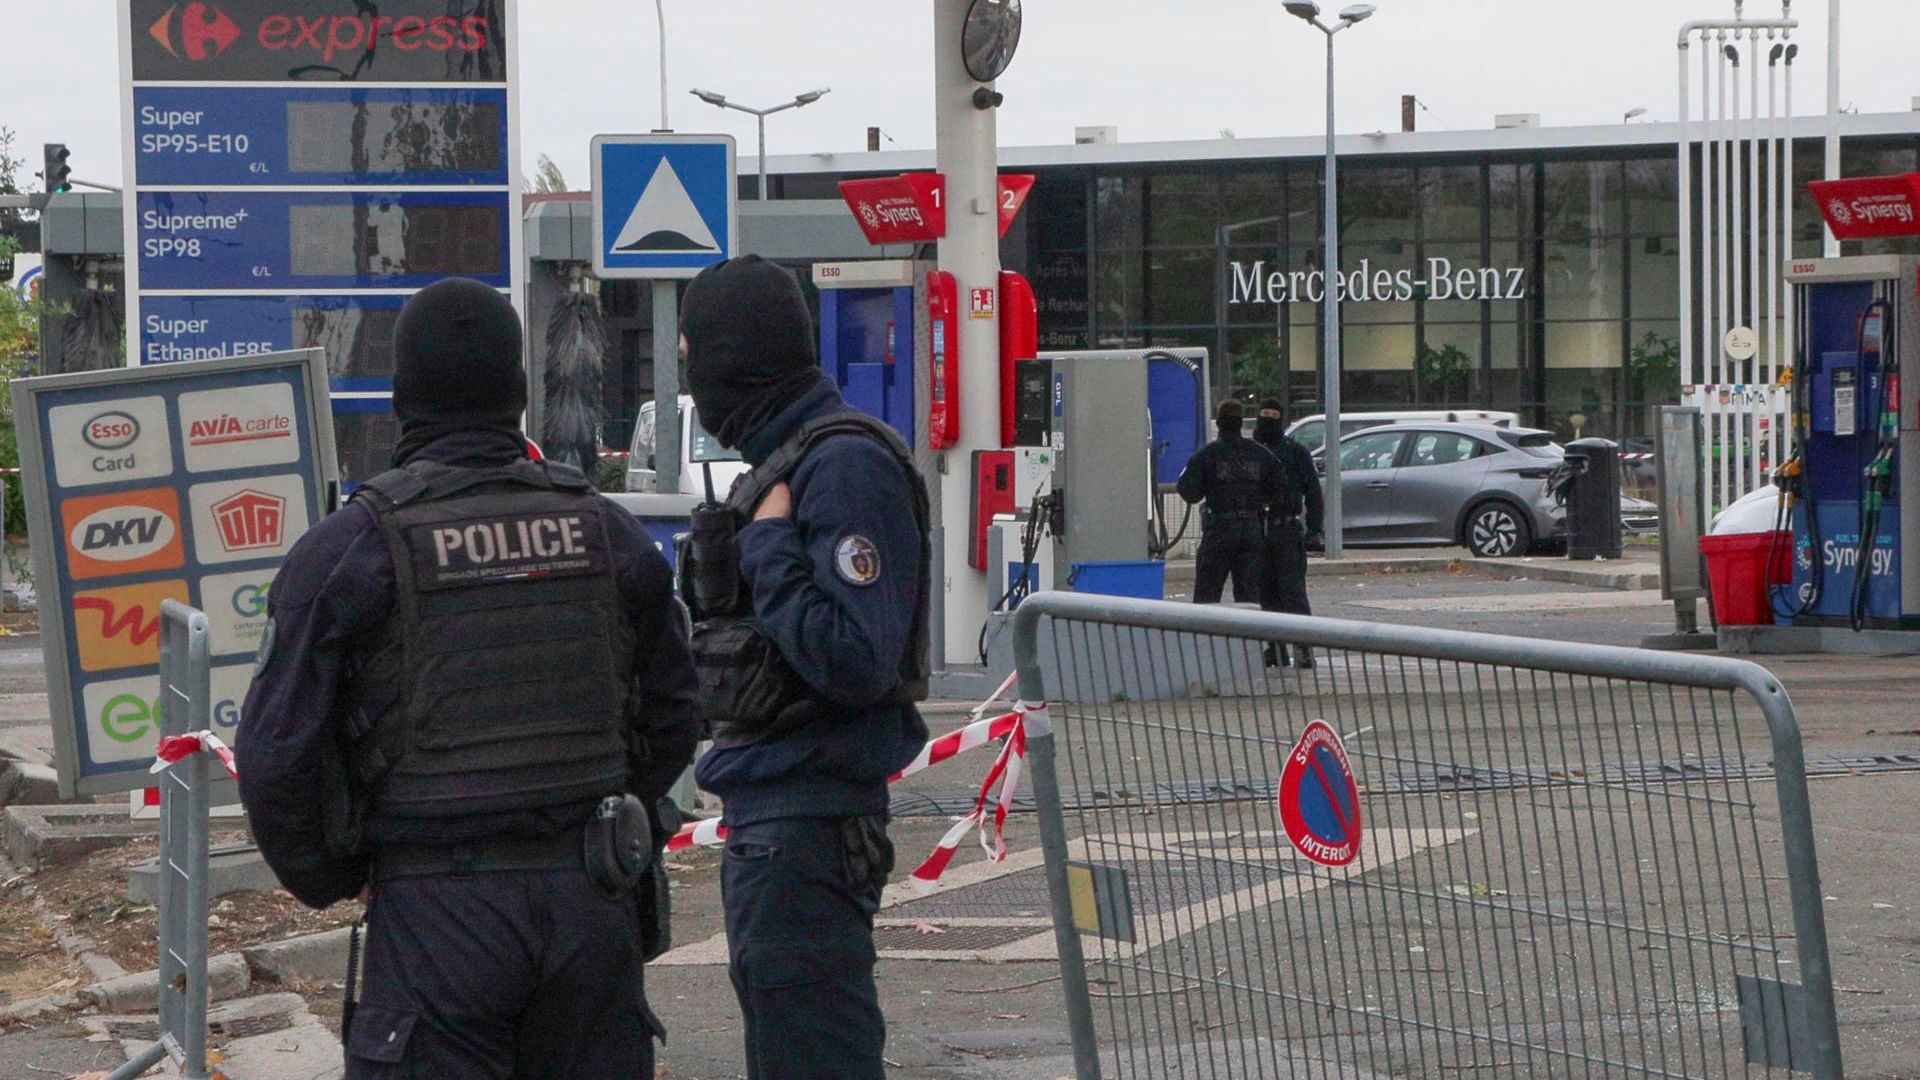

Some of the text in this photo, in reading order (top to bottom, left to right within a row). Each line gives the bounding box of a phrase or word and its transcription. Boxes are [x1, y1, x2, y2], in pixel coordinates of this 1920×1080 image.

[257, 14, 489, 62] express
[141, 107, 204, 131] Super
[142, 134, 249, 154] SP95-E10
[249, 162, 270, 173] €/L
[931, 188, 940, 208] 1
[1003, 190, 1016, 209] 2
[877, 204, 924, 228] Synerg
[1851, 200, 1914, 224] Synergy
[144, 239, 201, 258] SP98
[252, 265, 272, 277] €/L
[821, 266, 840, 278] ESSO
[1792, 263, 1816, 274] ESSO
[1229, 257, 1526, 304] Mercedes-Benz
[146, 315, 209, 339] Super
[147, 341, 272, 361] Ethanol E85
[1871, 375, 1878, 389] 3
[245, 414, 290, 432] carte
[92, 453, 135, 473] Card
[82, 515, 163, 551] DKV
[217, 503, 281, 547] UTA
[432, 517, 586, 567] POLICE
[1824, 540, 1893, 576] Syngy
[1296, 728, 1350, 776] STATIONNEMENT
[1300, 834, 1351, 861] INTERDIT
